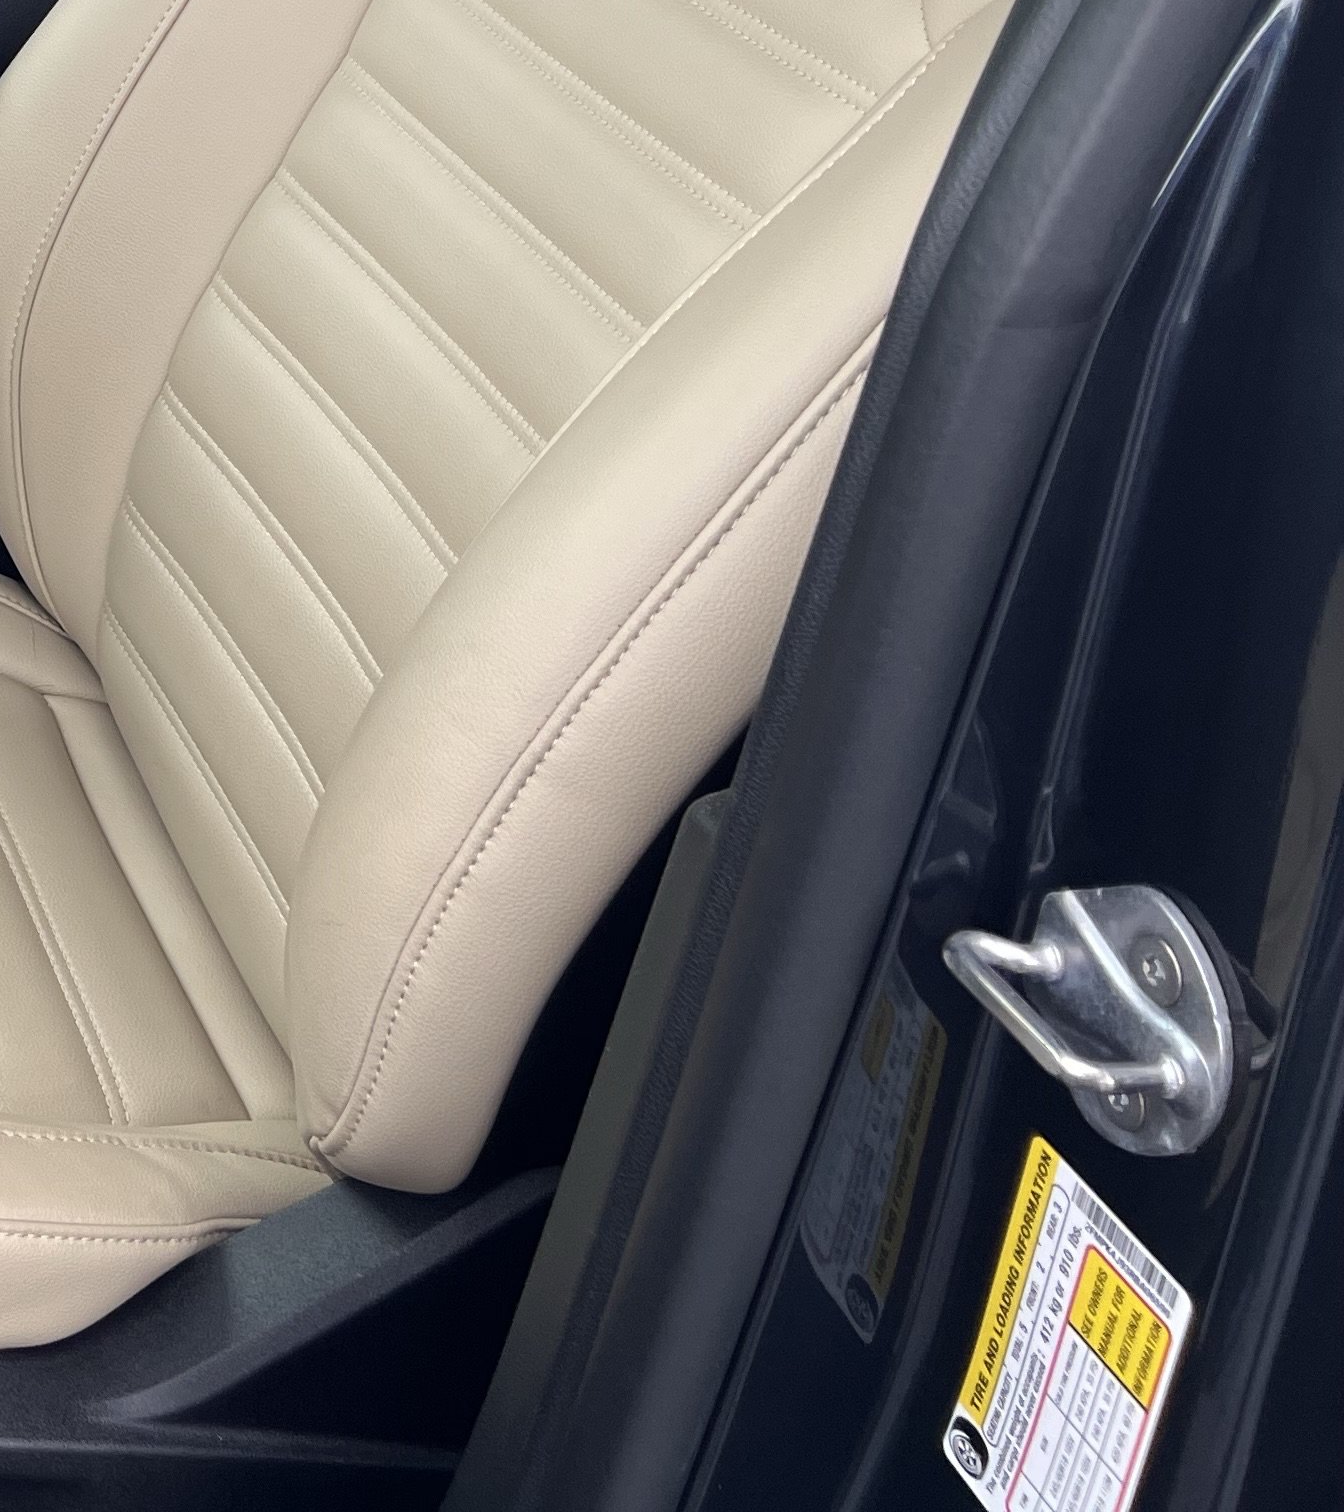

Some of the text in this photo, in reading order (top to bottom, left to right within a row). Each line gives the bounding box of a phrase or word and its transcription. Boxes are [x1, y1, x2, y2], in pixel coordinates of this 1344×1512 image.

[1035, 1259, 1045, 1273] 2
[1052, 1200, 1062, 1214] 3
[1057, 1246, 1074, 1279] 910
[1066, 1218, 1083, 1249] lbs.
[970, 1148, 1052, 1412] TIRE AND LOADING INFORMATION
[1047, 1294, 1062, 1317] kg
[1053, 1278, 1065, 1298] or
[1080, 1266, 1108, 1339] SEE OWNERS
[1039, 1316, 1054, 1345] 412
[1097, 1283, 1125, 1358] MANUAL FOR
[1115, 1305, 1142, 1375] ADDITIONAL
[1131, 1317, 1162, 1398] INFORMATION
